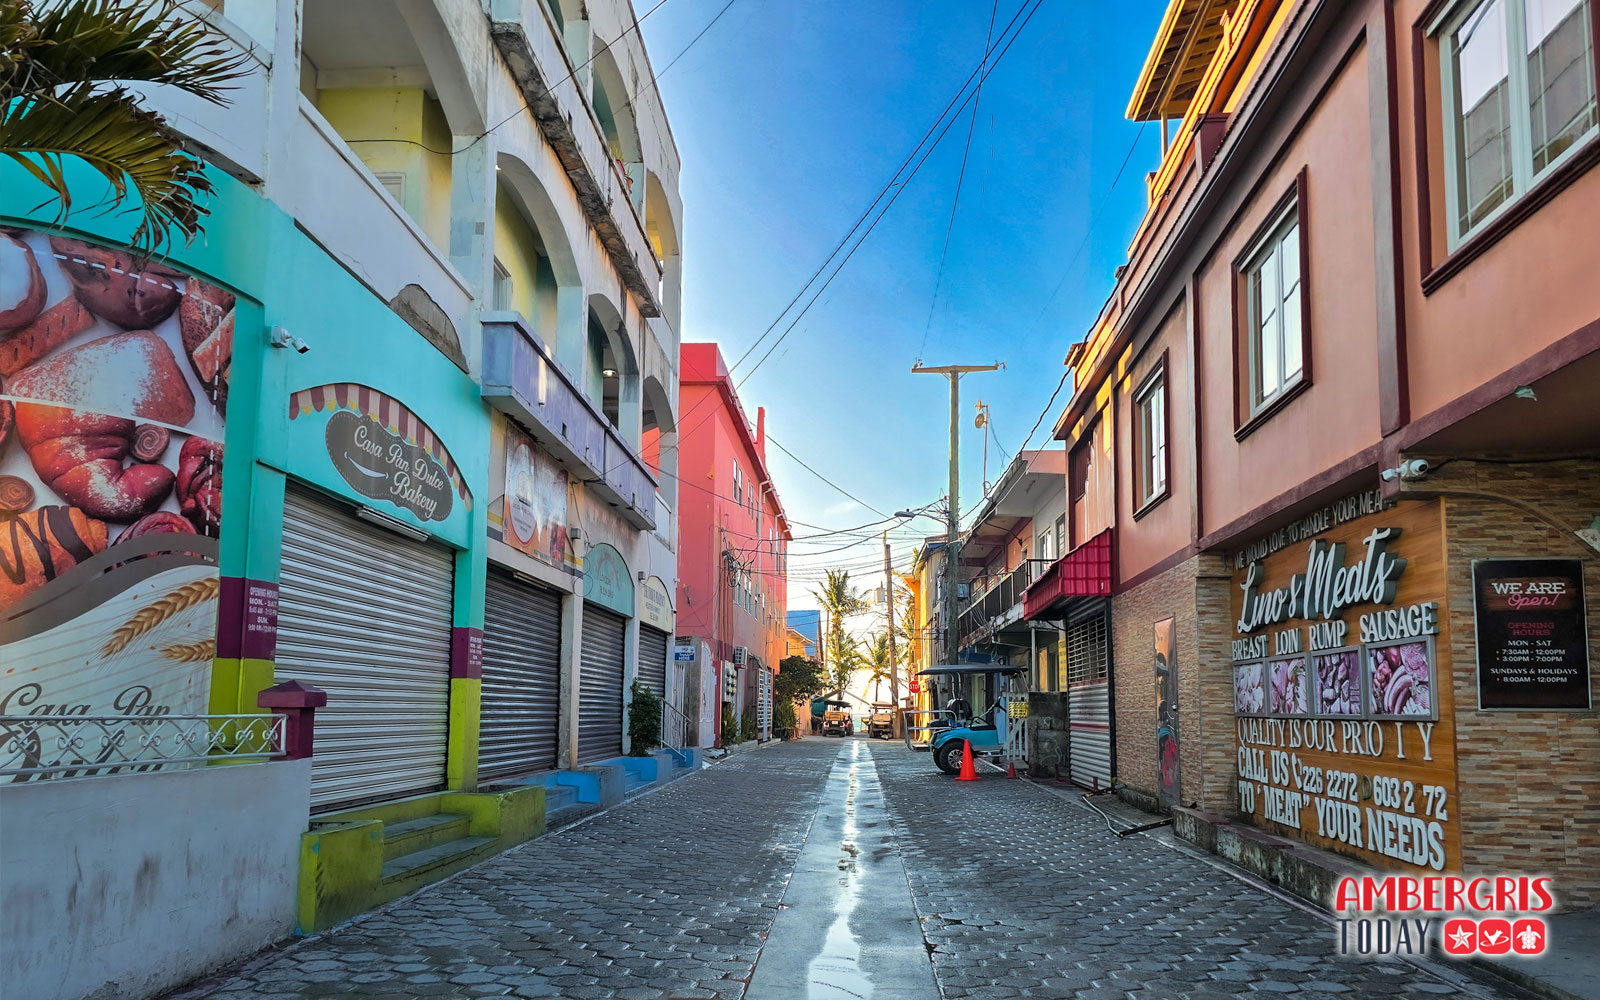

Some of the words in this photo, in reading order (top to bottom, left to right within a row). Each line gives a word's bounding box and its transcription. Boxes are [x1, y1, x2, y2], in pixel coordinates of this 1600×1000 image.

[354, 425, 383, 458] Casa
[385, 443, 410, 472] Pan
[412, 458, 444, 491] Dulce
[390, 471, 438, 518] Bakery
[1235, 549, 1245, 570] WE
[1246, 540, 1268, 564] WOULD
[1269, 527, 1286, 554] LOVE
[1287, 523, 1299, 543] TO
[1300, 507, 1330, 540] HANDLE
[1332, 496, 1357, 526] YOUR
[1303, 527, 1396, 620] Meats
[1491, 582, 1522, 594] WE
[1525, 582, 1566, 594] ARE
[1507, 592, 1560, 610] Open!
[1232, 634, 1267, 660] BREAST
[1275, 628, 1300, 656] LOIN
[1309, 619, 1346, 651] RUMP
[1359, 602, 1435, 643] SAUSAGE
[1507, 622, 1555, 630] OPENING
[1512, 629, 1551, 637] HOURS
[1490, 667, 1528, 675] SUNDAYS
[1538, 667, 1578, 675] HOLIDAYS
[0, 683, 91, 727] Casa
[102, 685, 170, 726] Pan
[1238, 717, 1286, 749] QUALITY
[1289, 719, 1302, 748] IS
[1304, 719, 1338, 752] OUR
[1238, 746, 1269, 784] CALL
[1270, 750, 1289, 786] US
[1303, 766, 1324, 793] 226
[1326, 769, 1359, 802] 2272
[1373, 775, 1401, 809] 603
[1239, 780, 1255, 813] TO
[1315, 796, 1363, 848] YOUR
[1366, 807, 1446, 871] NEEDS
